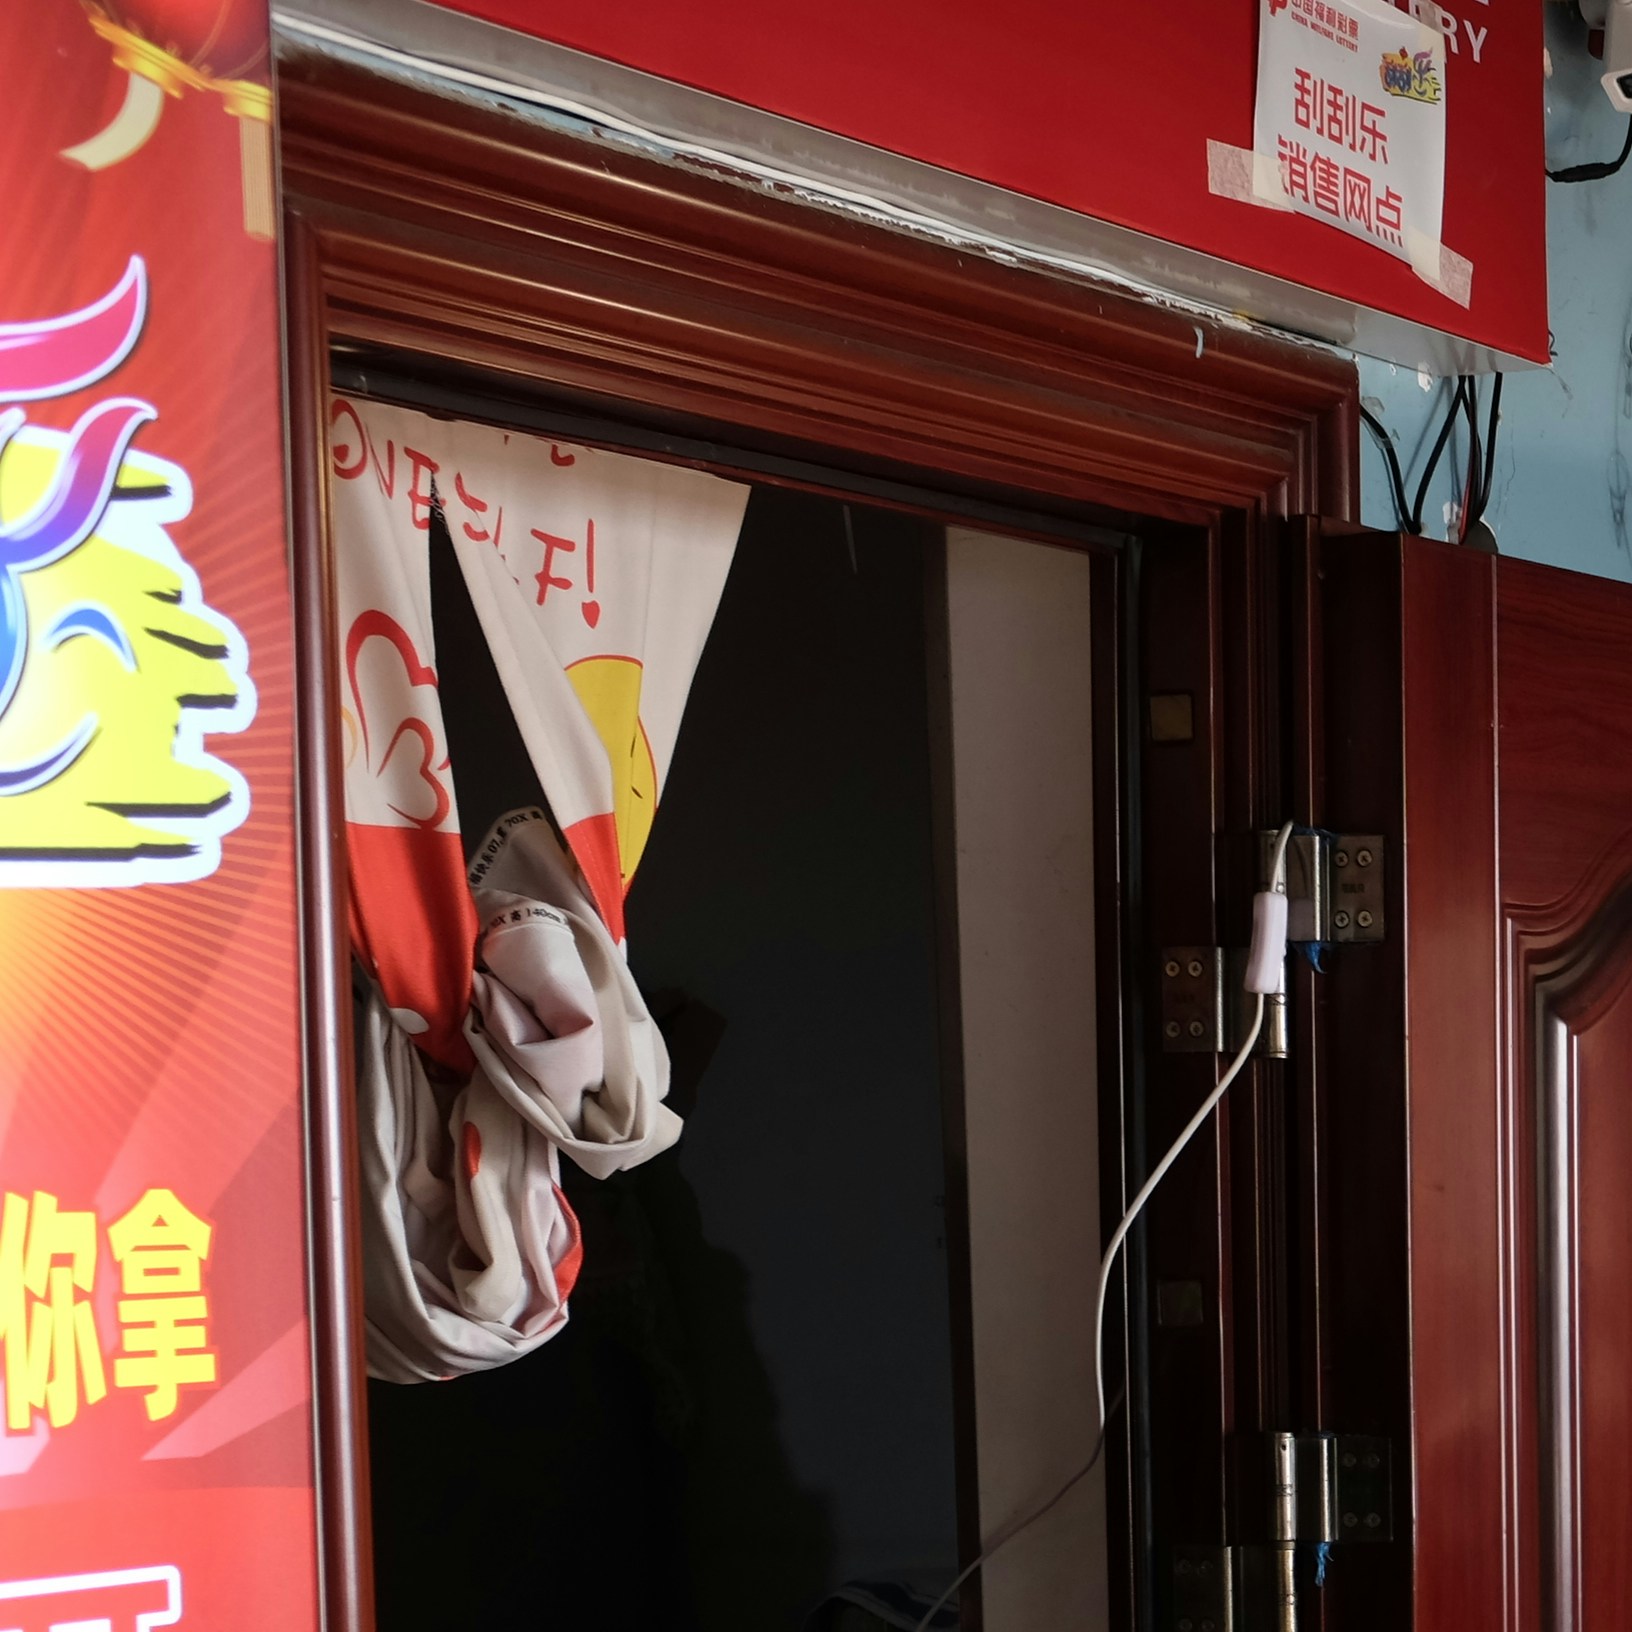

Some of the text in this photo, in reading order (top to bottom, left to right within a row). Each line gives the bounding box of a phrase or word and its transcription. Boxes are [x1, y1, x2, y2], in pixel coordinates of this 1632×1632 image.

[1294, 66, 1388, 165] 刮刮乐
[1277, 133, 1404, 248] 销售网点
